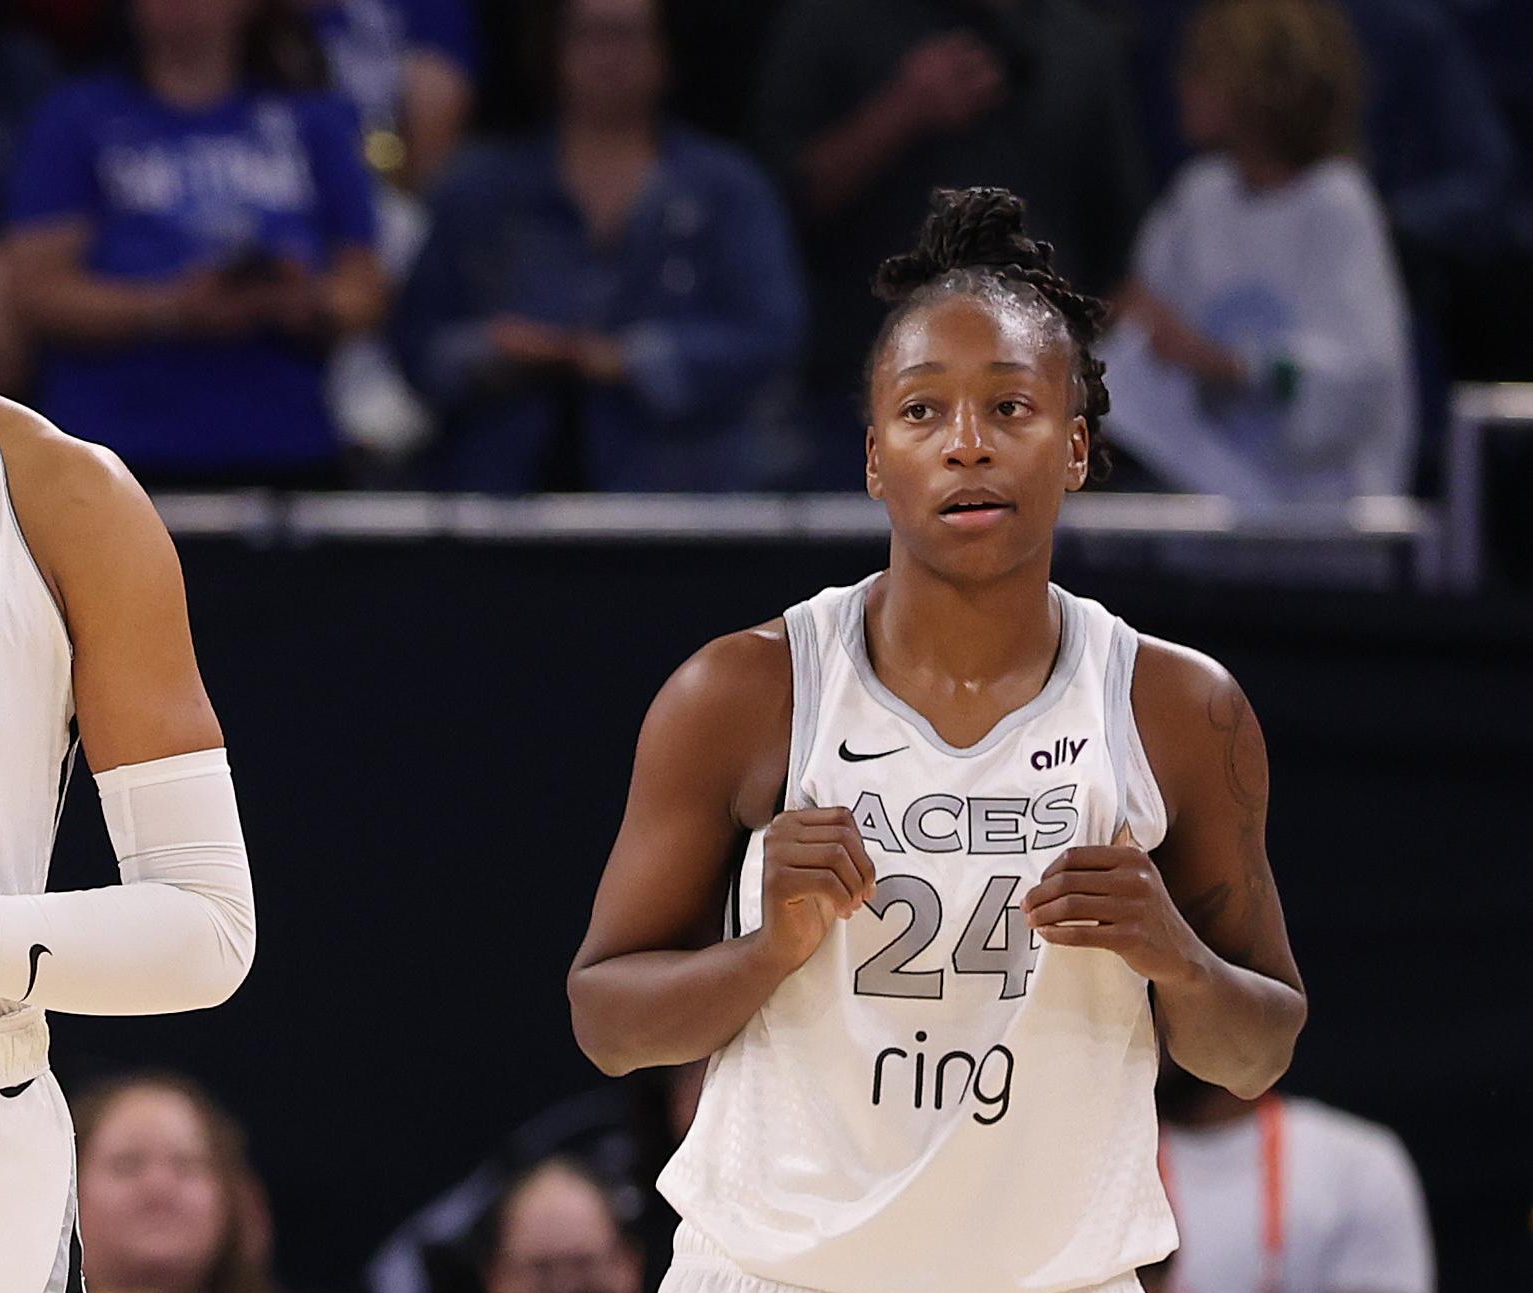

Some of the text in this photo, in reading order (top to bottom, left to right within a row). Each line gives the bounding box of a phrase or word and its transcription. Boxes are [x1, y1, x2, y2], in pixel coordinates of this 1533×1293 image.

[1030, 737, 1089, 772] ally
[852, 784, 1079, 855] ACES
[853, 873, 1041, 1000] 24
[871, 1030, 1014, 1126] ring
